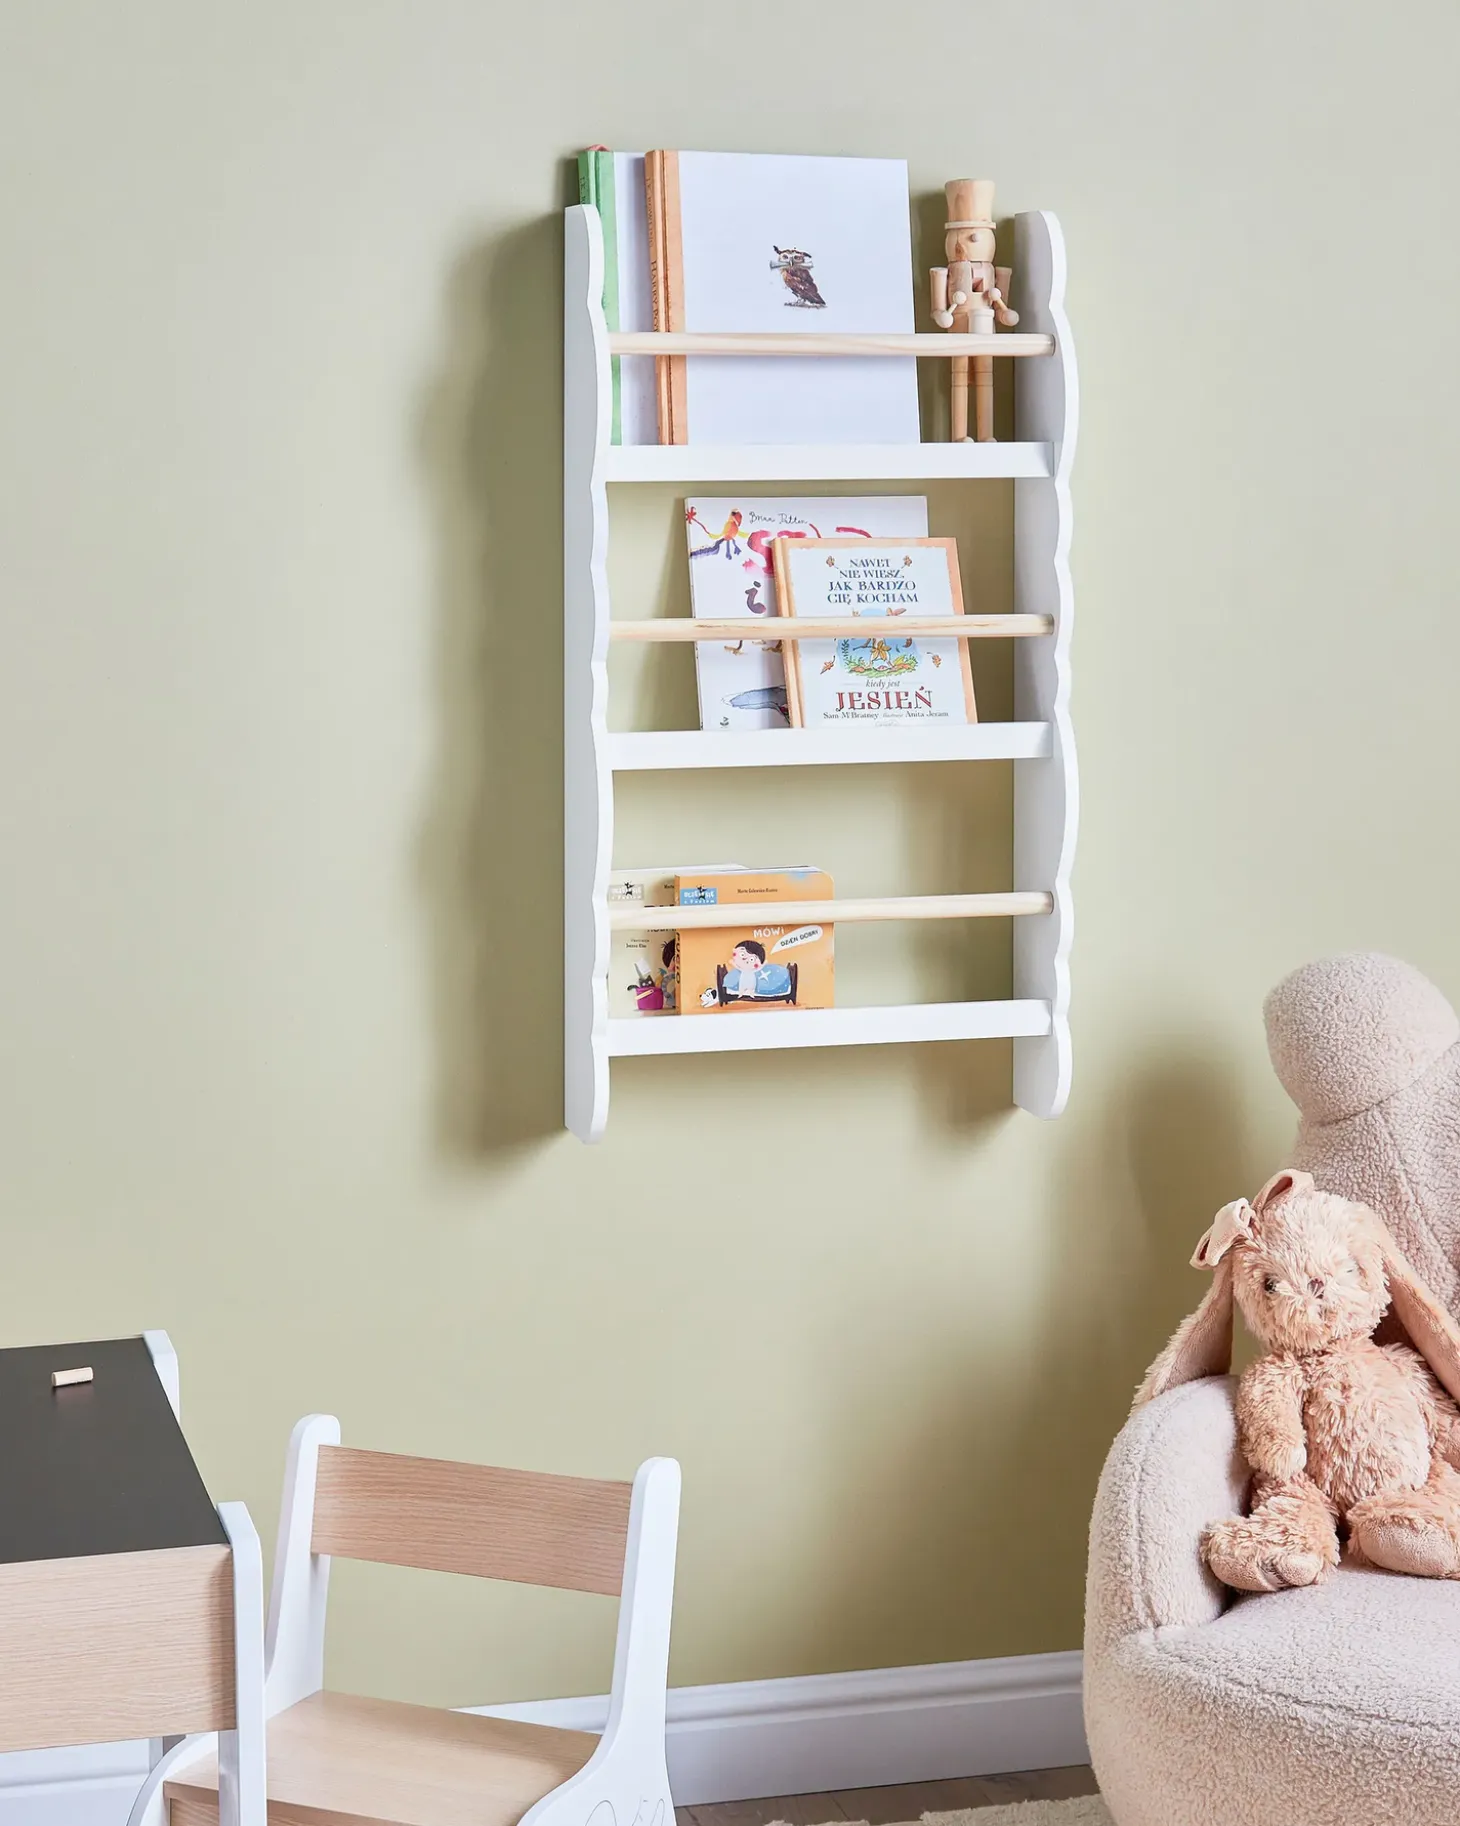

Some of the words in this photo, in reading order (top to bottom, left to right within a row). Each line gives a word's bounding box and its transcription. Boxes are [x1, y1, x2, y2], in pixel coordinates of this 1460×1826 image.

[650, 260, 659, 305] HARRY
[652, 309, 660, 333] POT
[849, 558, 891, 568] NAWET
[839, 569, 861, 579] NIE
[863, 569, 905, 579] WIESZ,
[828, 580, 853, 592] JAK
[858, 580, 916, 591] BARDZO
[826, 593, 852, 605] CIĘ
[856, 592, 919, 604] KOCHAM
[865, 679, 885, 690] kiedy
[885, 679, 900, 689] jest
[835, 685, 933, 711] JESIEŃ
[823, 711, 839, 719] Sam
[905, 709, 925, 718] Anita
